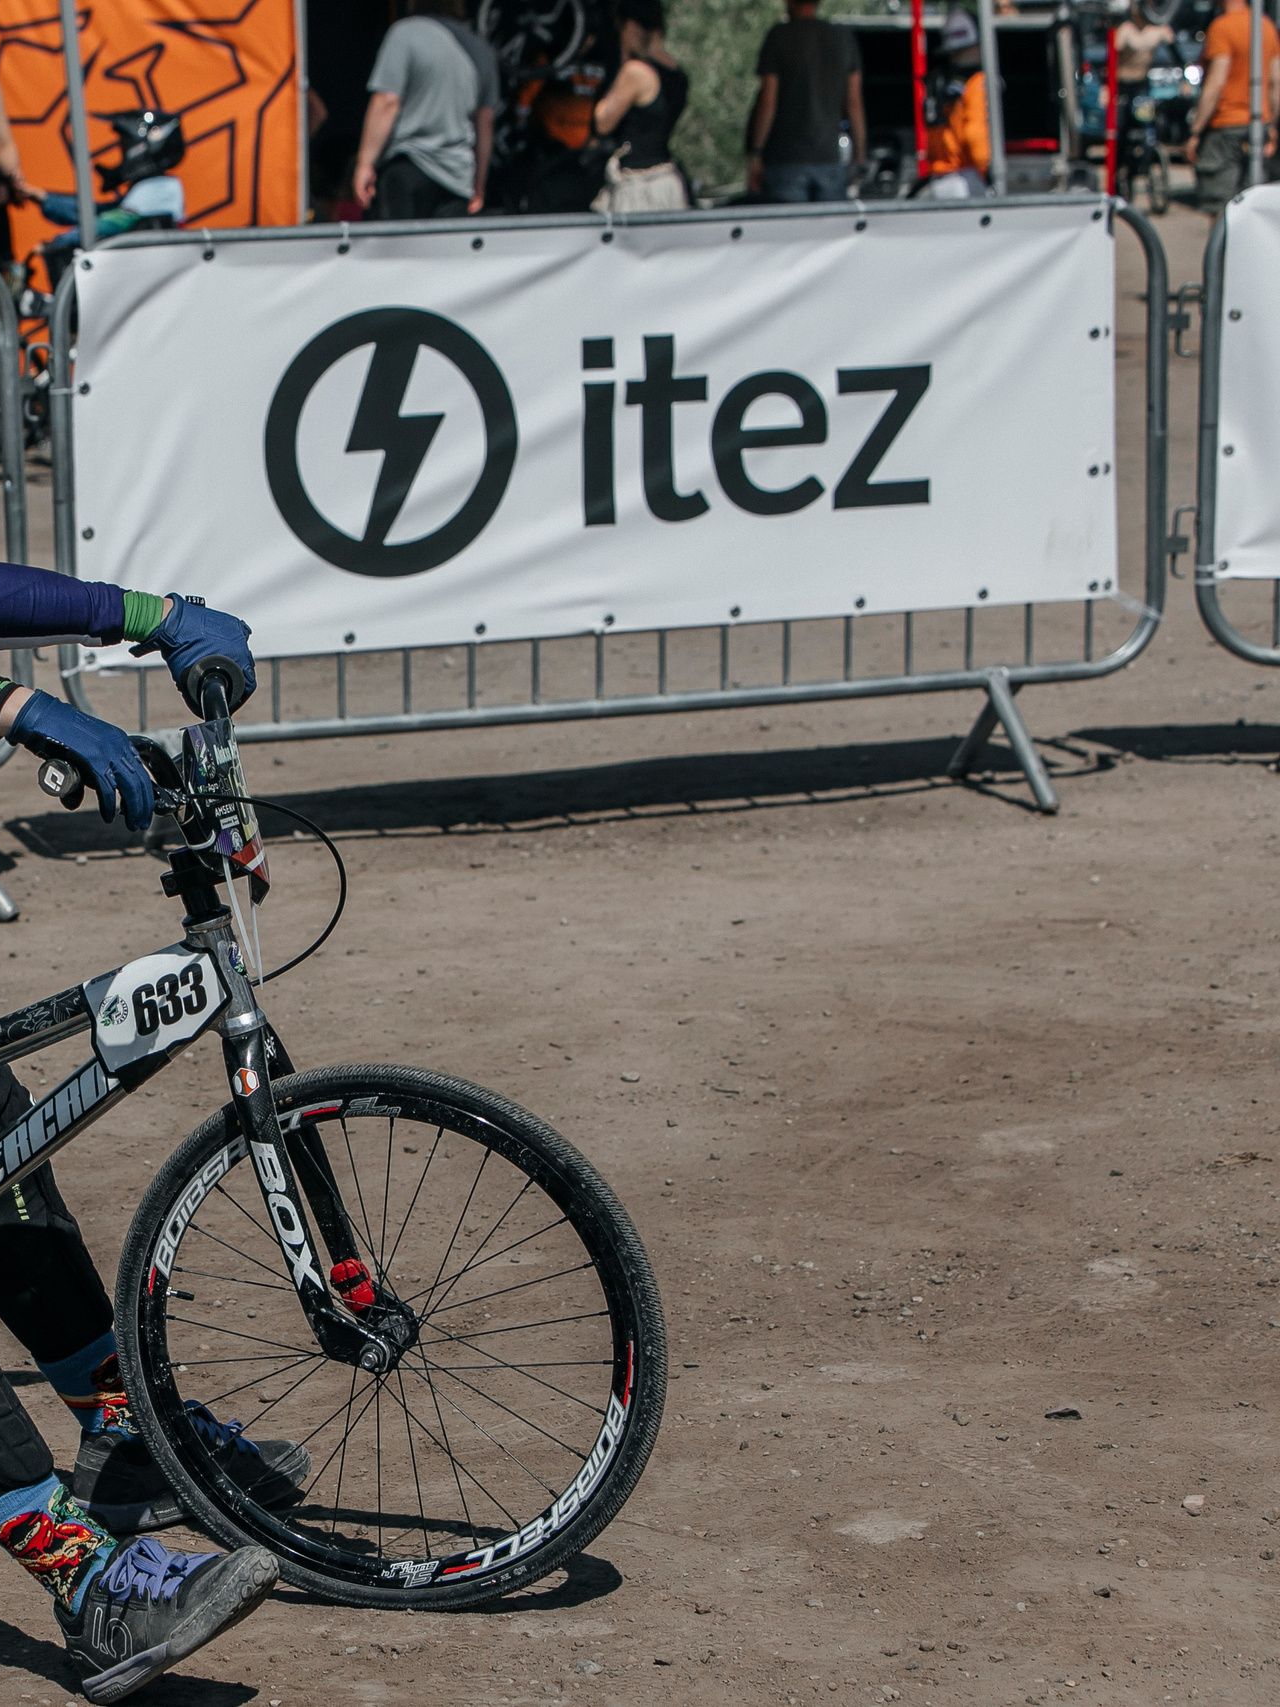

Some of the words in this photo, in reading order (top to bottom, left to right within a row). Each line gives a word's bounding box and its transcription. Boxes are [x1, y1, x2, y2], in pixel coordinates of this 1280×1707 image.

[582, 333, 932, 527] itez
[132, 963, 207, 1036] 633
[250, 1140, 325, 1291] BOX
